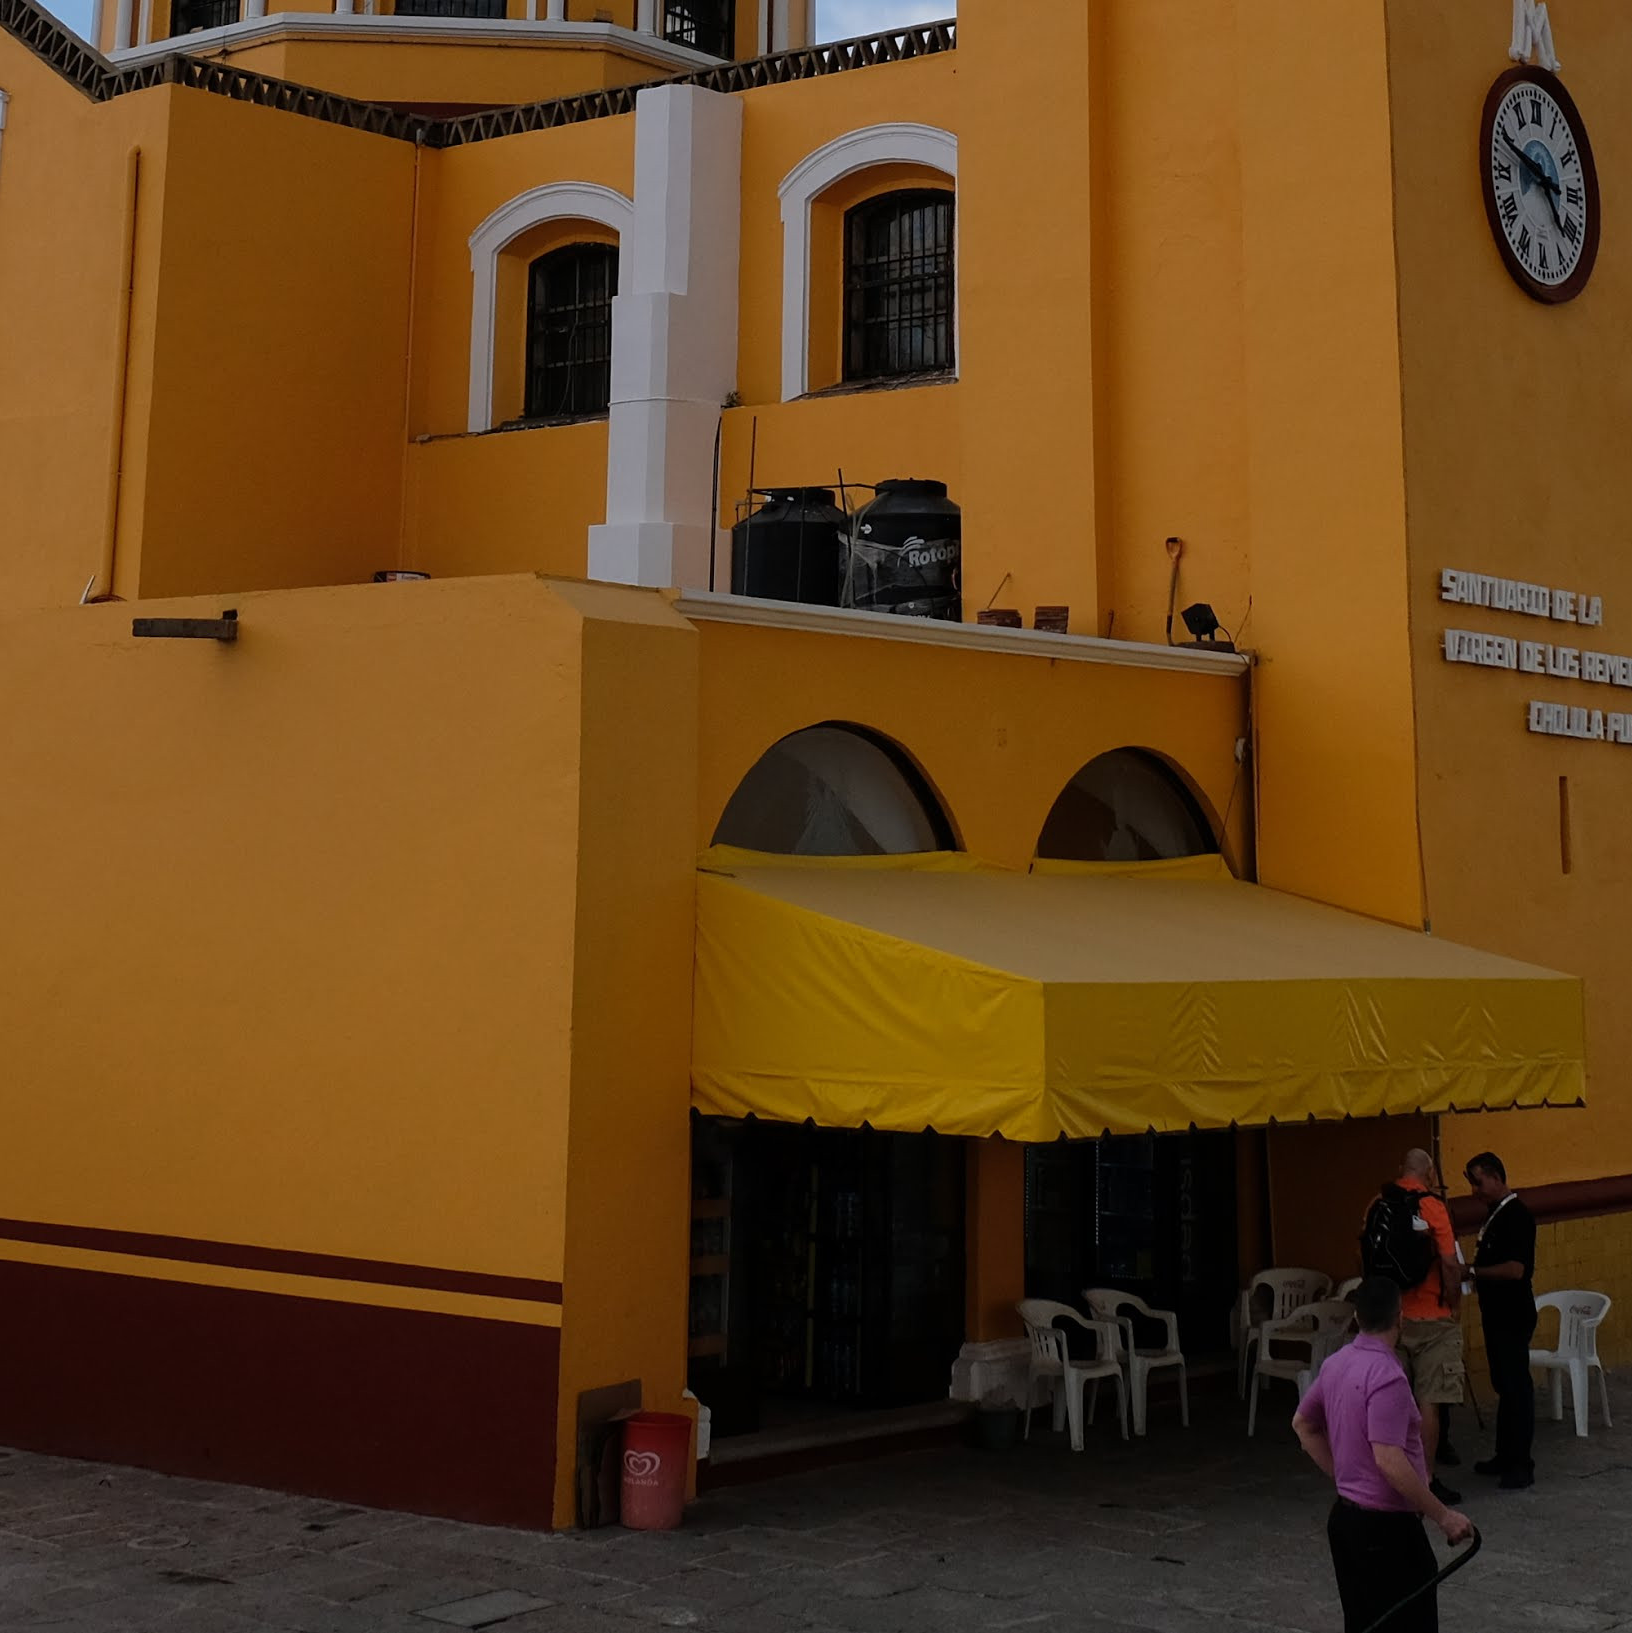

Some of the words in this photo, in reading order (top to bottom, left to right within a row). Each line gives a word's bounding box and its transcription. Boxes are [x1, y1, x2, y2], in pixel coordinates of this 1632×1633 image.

[1441, 567, 1550, 617] SANTUARIO
[1550, 590, 1576, 622] DE
[1577, 593, 1603, 626] LA
[1444, 628, 1518, 670] VIRGEN
[1518, 640, 1545, 674] DE
[1545, 644, 1580, 679] LOS
[1529, 700, 1605, 741] CHOLULA
